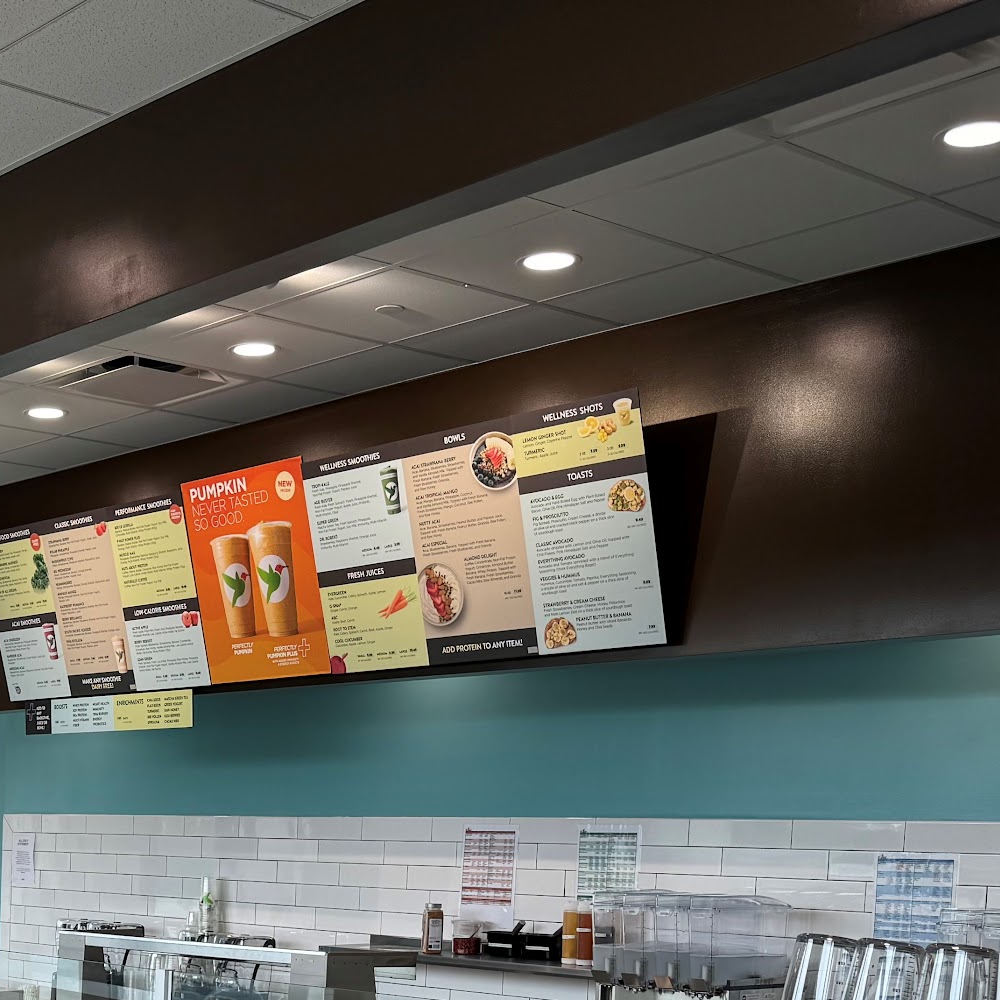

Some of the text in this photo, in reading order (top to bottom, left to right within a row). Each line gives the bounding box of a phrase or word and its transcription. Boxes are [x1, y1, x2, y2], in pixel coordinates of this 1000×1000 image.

[542, 402, 604, 423] WELLNESS SHOTS
[443, 433, 466, 445] BOWLS
[522, 436, 538, 444] LEMON
[538, 432, 554, 441] GINGER
[524, 448, 545, 456] TURMERIC
[319, 452, 381, 472] WELLNESS SMOOTHIES
[567, 469, 594, 482] TOASTS
[277, 478, 293, 489] NEW
[189, 477, 248, 503] PUMPKIN
[425, 491, 443, 499] TROPICAL
[443, 488, 459, 496] MANGO
[191, 489, 269, 518] NEVER TASTED
[530, 496, 551, 504] AVOCADO
[115, 499, 172, 516] PERFORMANCE SMOOTHIES
[194, 510, 245, 532] SO GOOD.
[543, 512, 569, 520] PROSCIUTTO
[54, 516, 93, 529] CLASSIC SMOOTHIES
[9, 529, 31, 538] SMOOTHIES
[538, 557, 563, 565] EVERYTHING
[347, 568, 385, 580] FRESH JUICES
[133, 603, 187, 616] LOW-CALORIE SMOOTHIES
[231, 642, 255, 651] PERFECTLY
[234, 648, 253, 656] PUMPKIN
[273, 644, 298, 653] PERFECTLY
[442, 639, 524, 654] ADD PROTEIN TO ANY ITEM!
[267, 650, 299, 660] PUMPKIN PLUS
